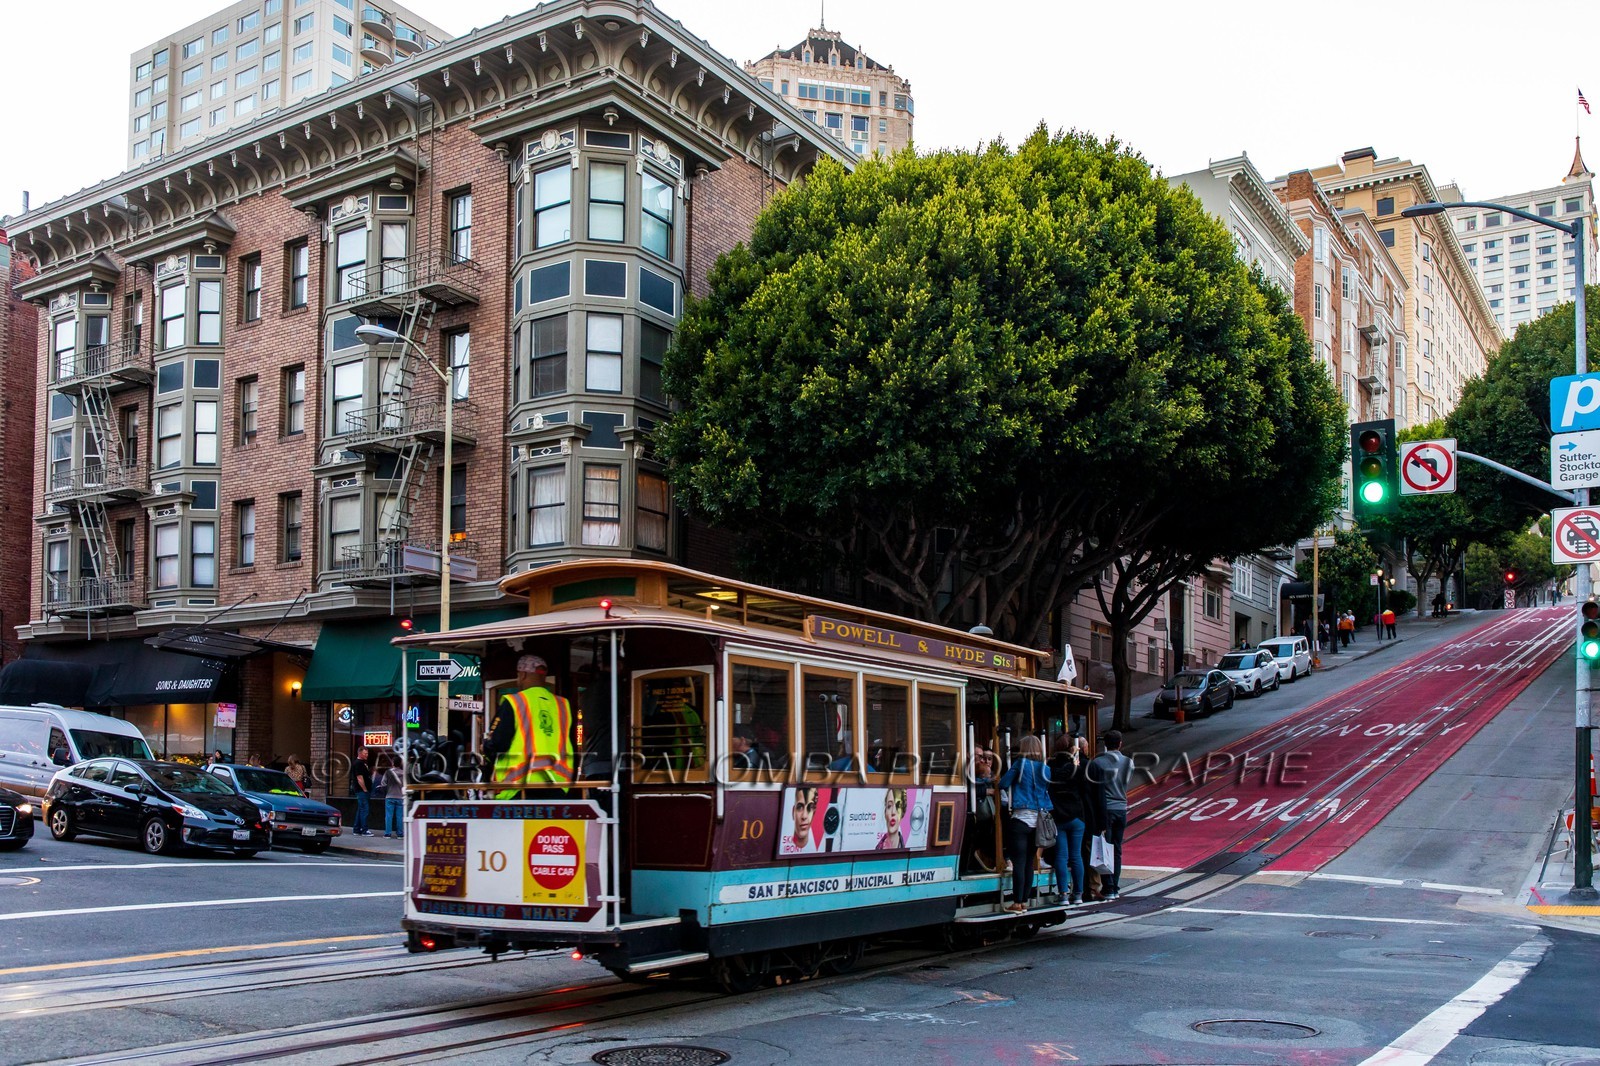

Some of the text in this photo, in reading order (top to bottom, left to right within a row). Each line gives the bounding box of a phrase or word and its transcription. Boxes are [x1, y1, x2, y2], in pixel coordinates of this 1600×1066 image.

[1559, 453, 1597, 463] Sutter-
[1559, 461, 1600, 472] Stockto
[1559, 471, 1599, 481] Garage
[820, 620, 1014, 668] POWELL & HYDE Sts.
[420, 666, 450, 675] ONE WAY
[155, 679, 213, 691] SONS & DAUGHTERS
[453, 701, 480, 709] POWELL
[1363, 722, 1468, 737] ONLY
[427, 806, 480, 818] MARKET
[491, 806, 555, 818] STREET
[427, 828, 465, 837] POWELL
[740, 820, 764, 841] 10
[537, 835, 570, 844] DO NOT
[427, 845, 465, 854] MARKET
[542, 844, 565, 853] PASS
[477, 851, 507, 872] 10
[532, 866, 575, 876] CABLE CAR
[748, 870, 936, 899] SAN FRANCISCO MUNICIPAL RAILWAY
[421, 900, 580, 921] FISHERMANS WHARF
